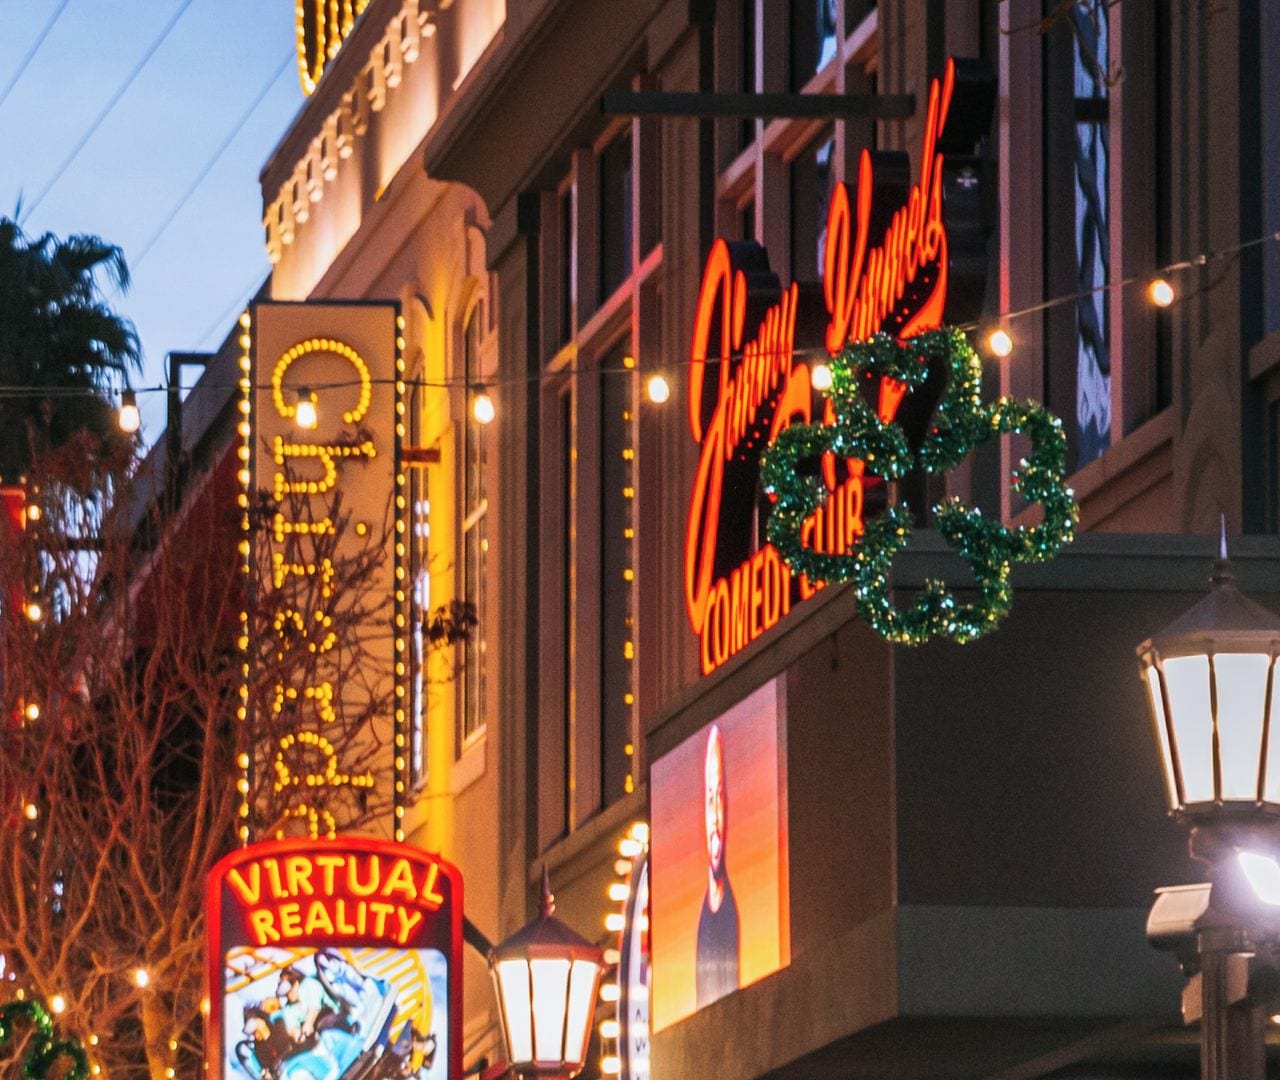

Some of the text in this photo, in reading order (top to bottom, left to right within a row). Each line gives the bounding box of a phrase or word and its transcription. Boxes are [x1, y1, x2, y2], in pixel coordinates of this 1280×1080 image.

[684, 237, 812, 635] Jimmy
[226, 854, 444, 906] VIRTUAL
[249, 898, 423, 946] REALITY
